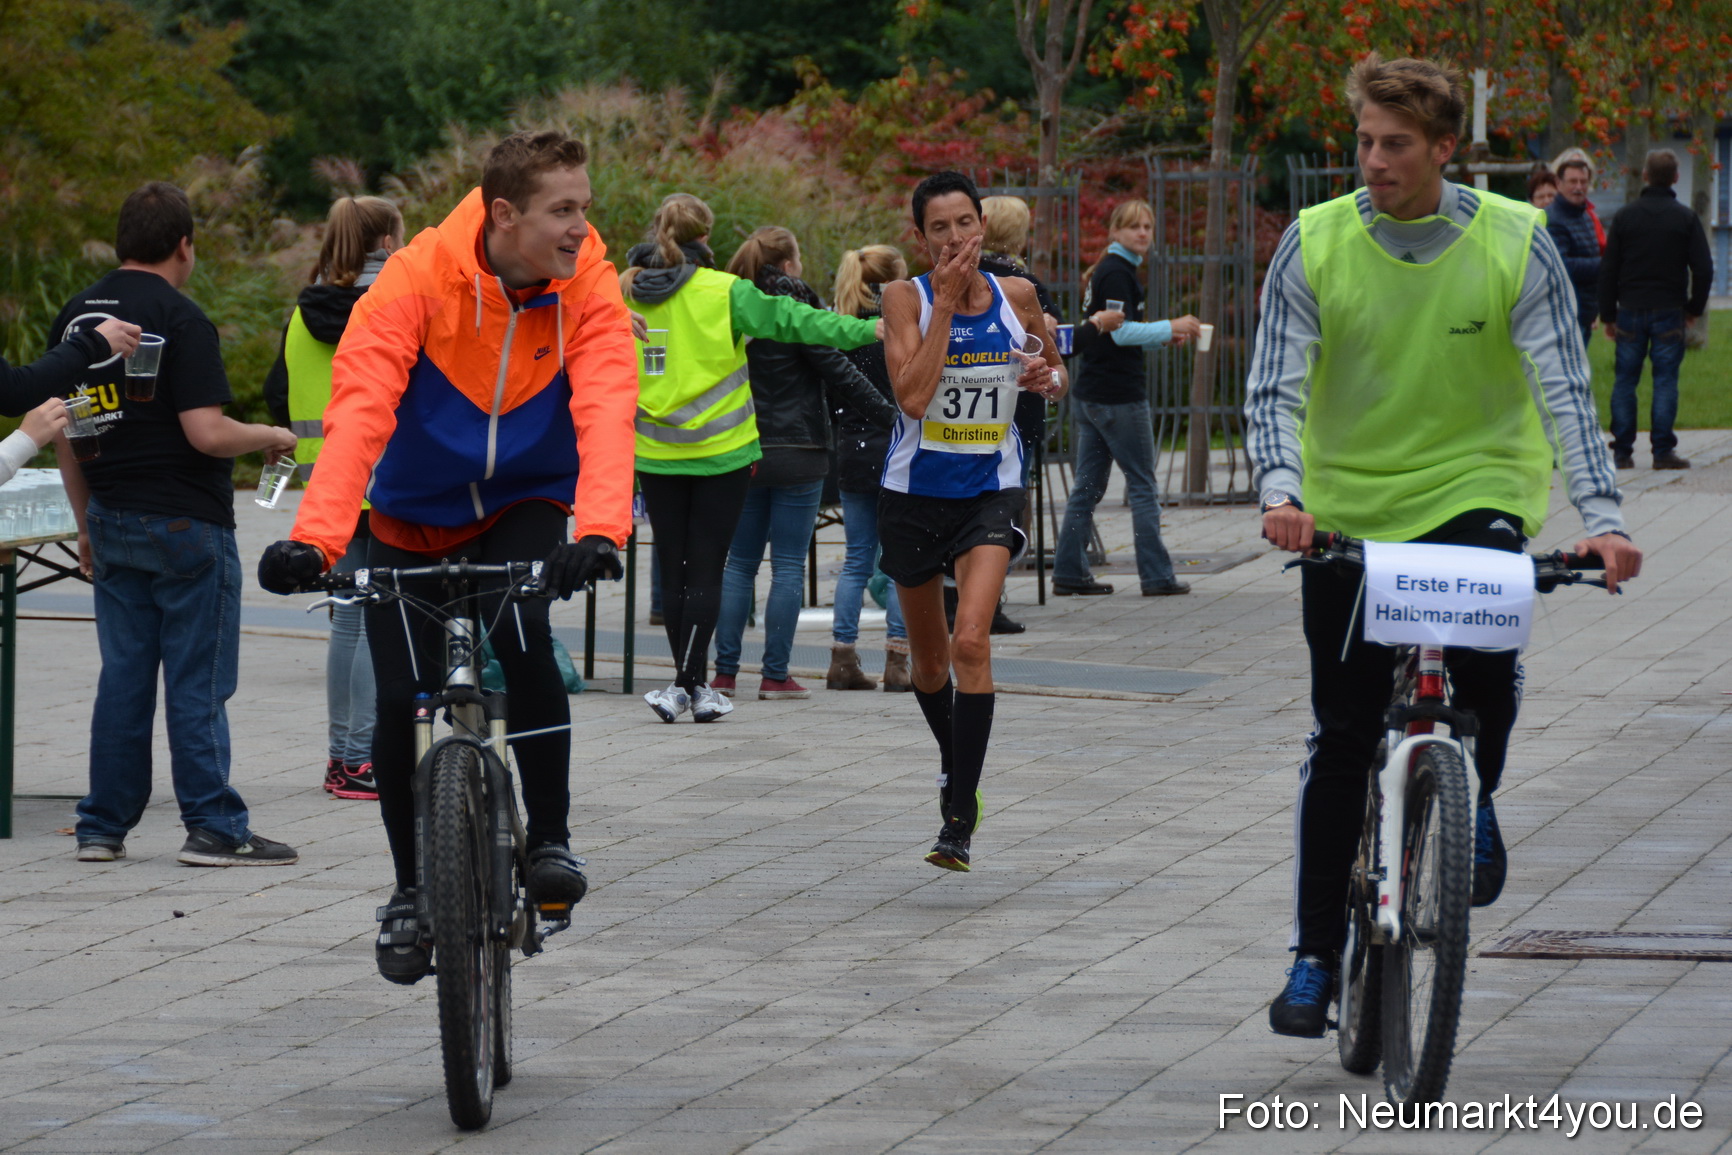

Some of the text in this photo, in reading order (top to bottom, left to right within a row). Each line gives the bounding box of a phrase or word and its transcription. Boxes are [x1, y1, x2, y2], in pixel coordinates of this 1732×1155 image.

[949, 327, 974, 337] EITEC
[1448, 327, 1477, 335] JAKO
[944, 351, 1009, 366] AC QUELLE
[940, 374, 1005, 385] RTL Neumarkt
[942, 386, 999, 420] 371
[942, 427, 999, 441] Christine
[1396, 574, 1502, 596] Erste Frau
[1375, 603, 1520, 628] Halbmarathon
